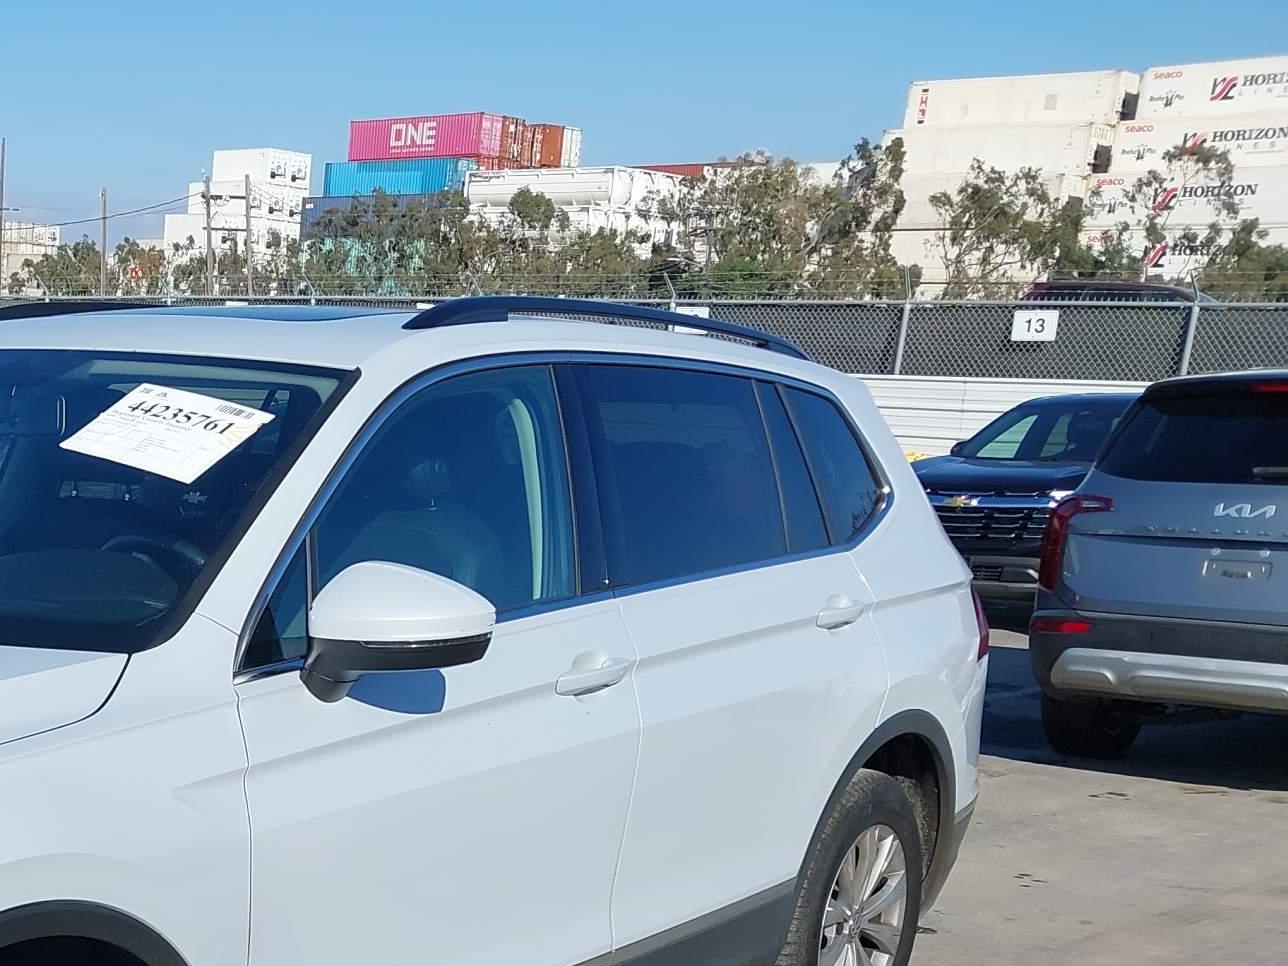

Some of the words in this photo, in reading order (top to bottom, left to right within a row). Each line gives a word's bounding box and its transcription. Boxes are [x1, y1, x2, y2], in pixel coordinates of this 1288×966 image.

[1153, 71, 1183, 79] seaco
[390, 122, 436, 146] ONE
[1125, 124, 1154, 133] seaco
[1212, 127, 1288, 142] HORIZON
[1096, 178, 1125, 187] seaco
[1025, 318, 1046, 333] 13
[128, 399, 236, 435] 44235761
[1214, 503, 1276, 519] KIA
